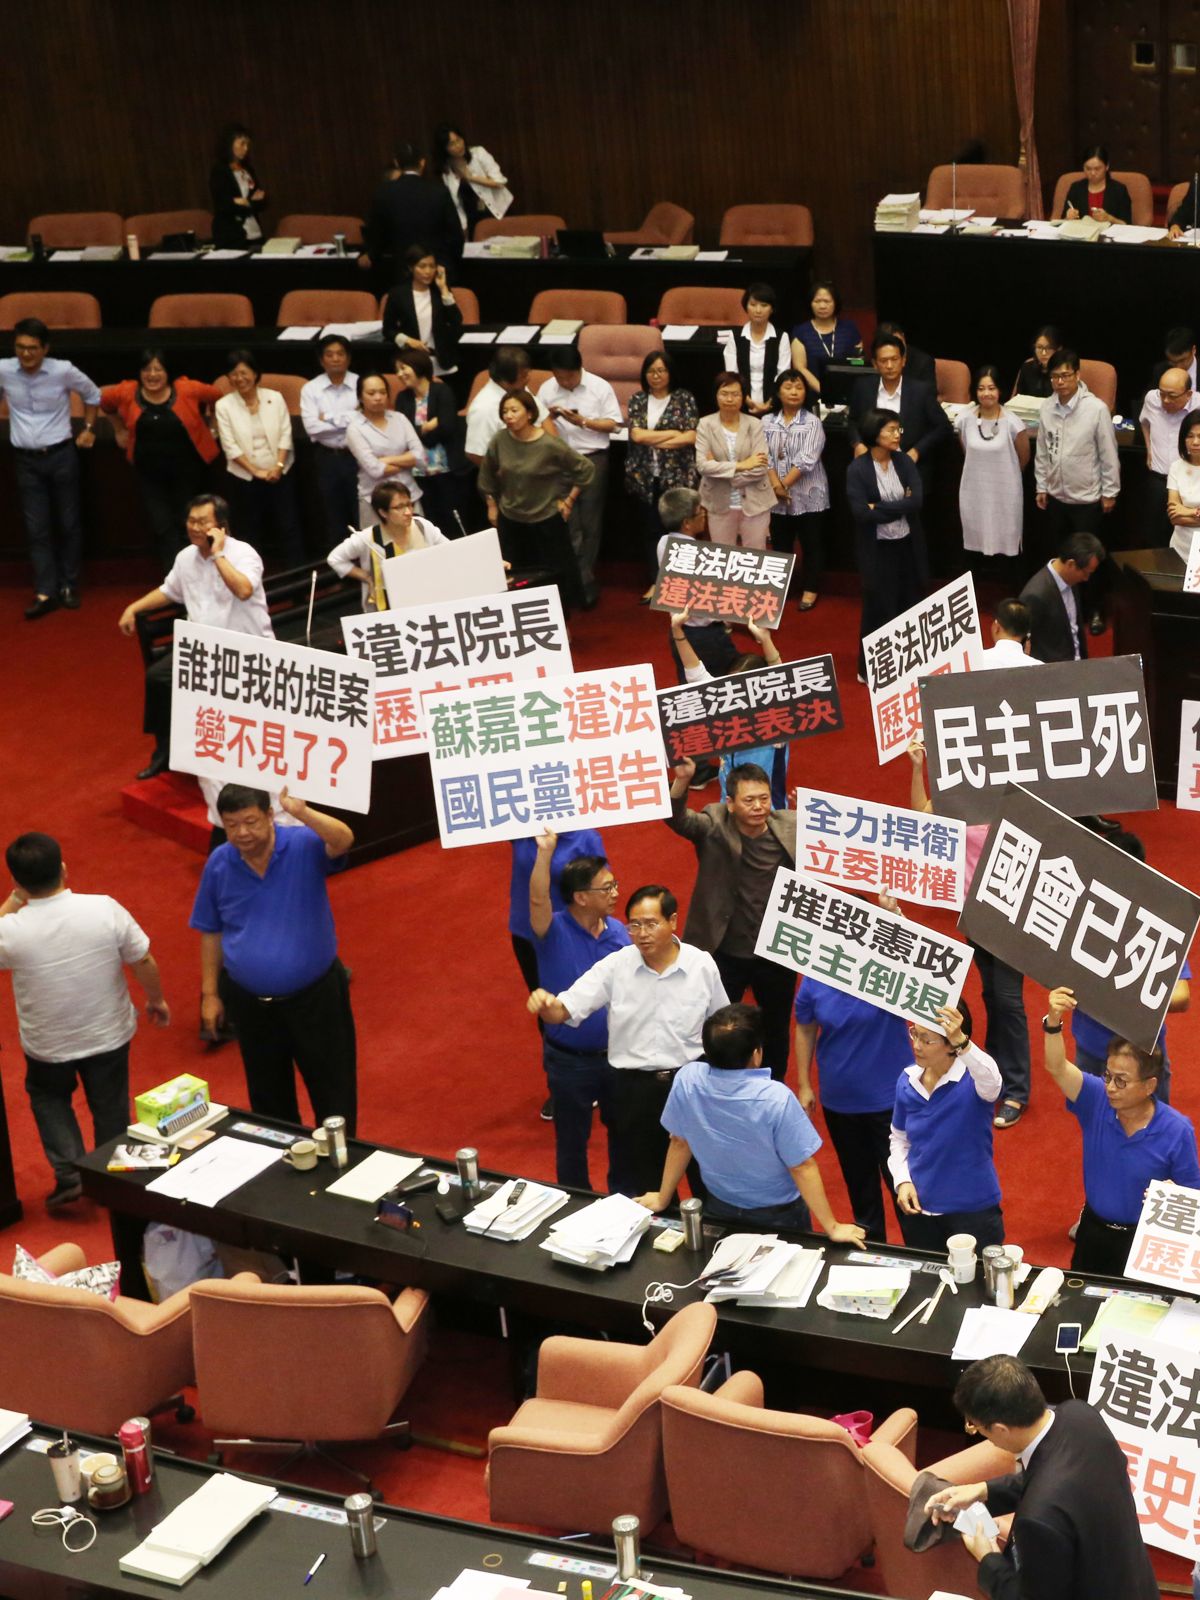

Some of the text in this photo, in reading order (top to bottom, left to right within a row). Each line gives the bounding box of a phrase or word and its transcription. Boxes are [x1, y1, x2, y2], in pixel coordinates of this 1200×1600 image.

[657, 575, 784, 622] 違法表決
[665, 542, 788, 589] 違法院長
[352, 598, 562, 678] 違法院長
[868, 585, 976, 694] 違法院長
[178, 637, 370, 728] 誰把我的提案
[430, 676, 656, 760] 蘇嘉全違法
[662, 661, 832, 727] 違法院長
[877, 650, 972, 751] 歷史
[669, 698, 840, 761] 違法表決
[933, 691, 1147, 792] 民主已死
[441, 749, 663, 835] 國民黨提告
[804, 797, 959, 862] 全力捍衛
[803, 840, 957, 904] 立委職權
[976, 818, 1185, 1011] 國會已死
[766, 921, 949, 1024] 民主倒退
[778, 879, 964, 985] 摧毀憲政
